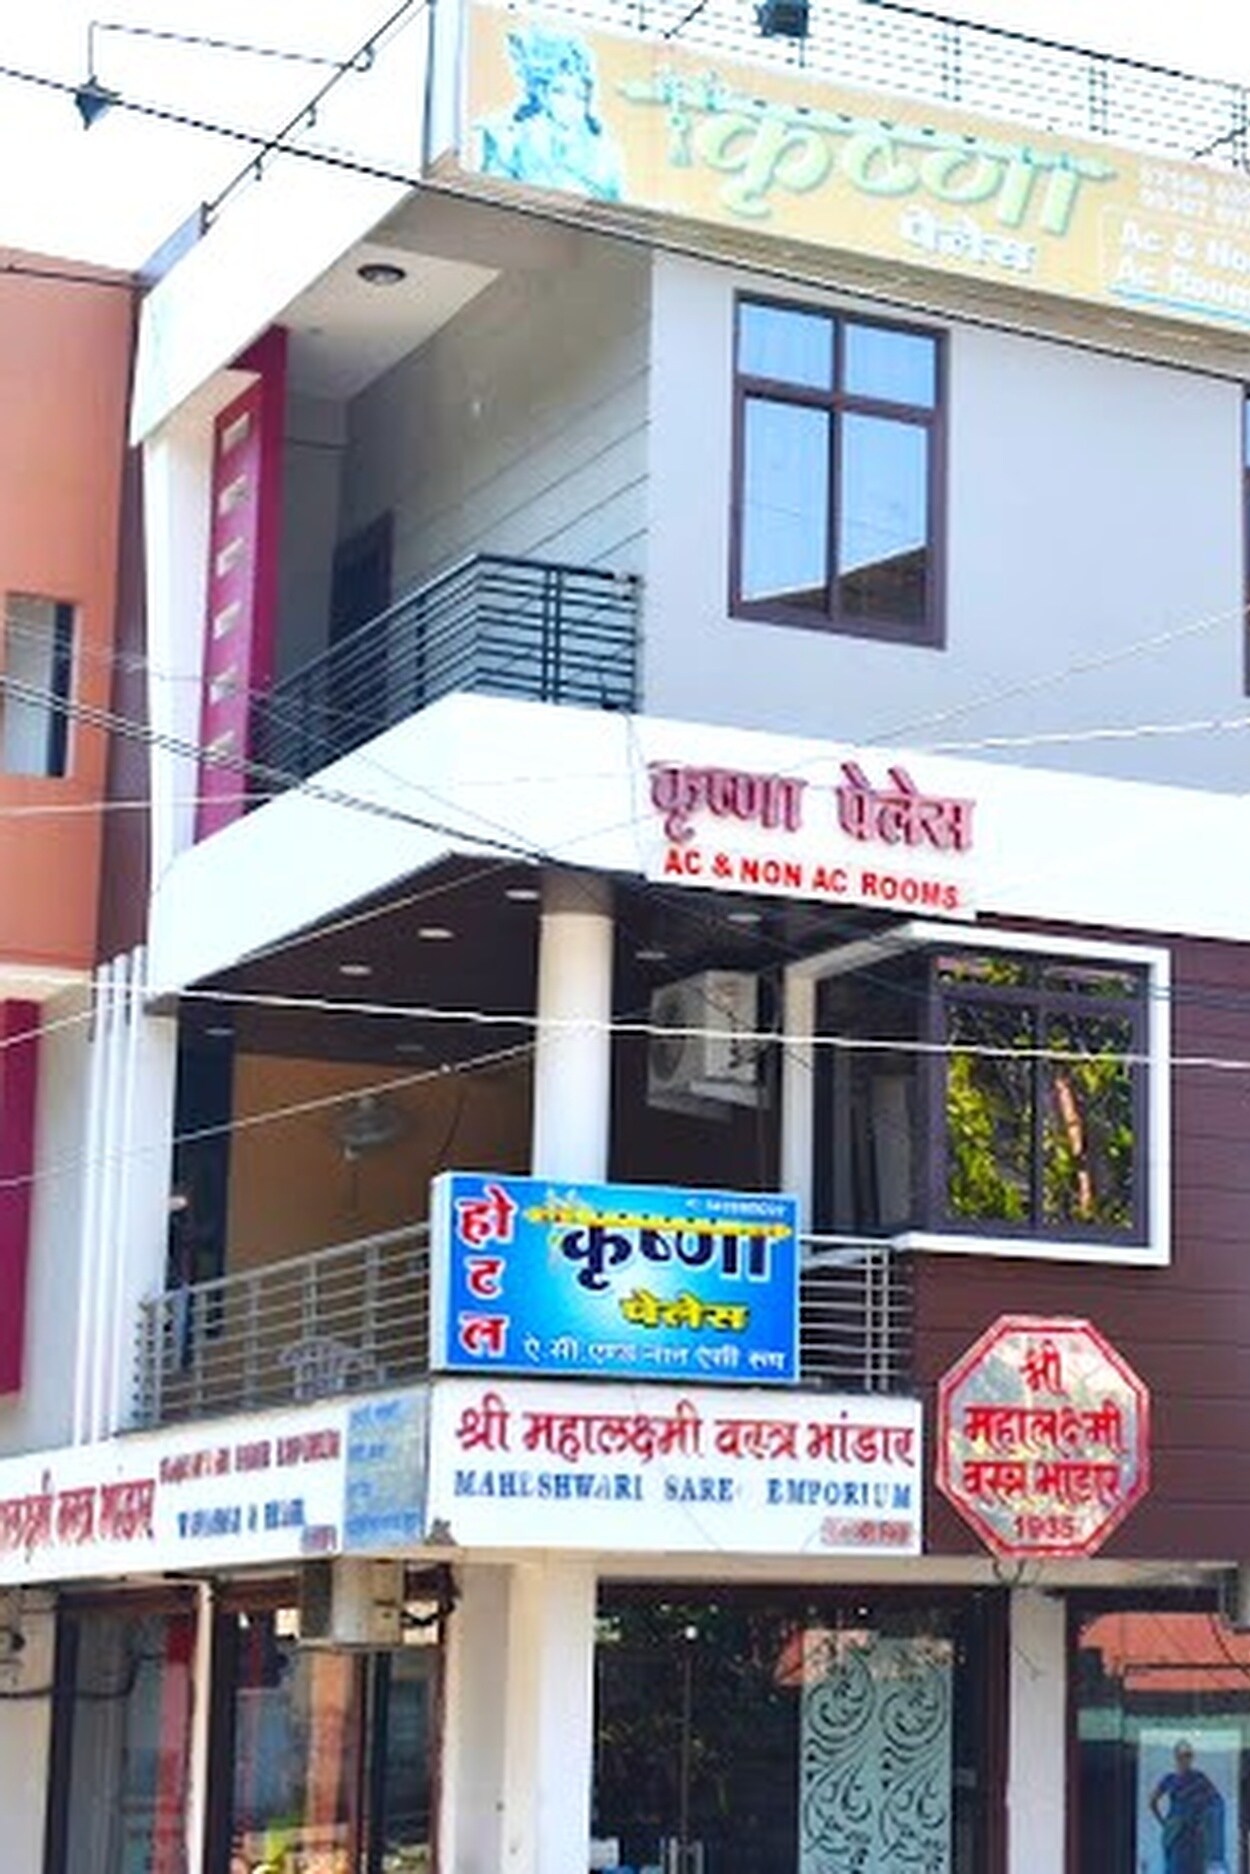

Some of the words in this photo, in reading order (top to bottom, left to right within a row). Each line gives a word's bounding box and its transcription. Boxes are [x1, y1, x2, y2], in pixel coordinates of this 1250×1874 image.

[647, 760, 809, 844] कृष्णा
[664, 849, 701, 877] AC
[711, 854, 733, 878] &
[740, 858, 801, 889] NON
[811, 868, 849, 893] AC
[861, 872, 960, 911] ROOMS
[545, 1205, 790, 1291] कृष्णा
[1020, 1338, 1067, 1397] श्री
[455, 1392, 511, 1452] श्री
[521, 1398, 704, 1465] महालक्ष्मी
[714, 1417, 798, 1462] वस्त्र
[805, 1409, 916, 1468] भांडार
[766, 1478, 913, 1510] EMPORIUM
